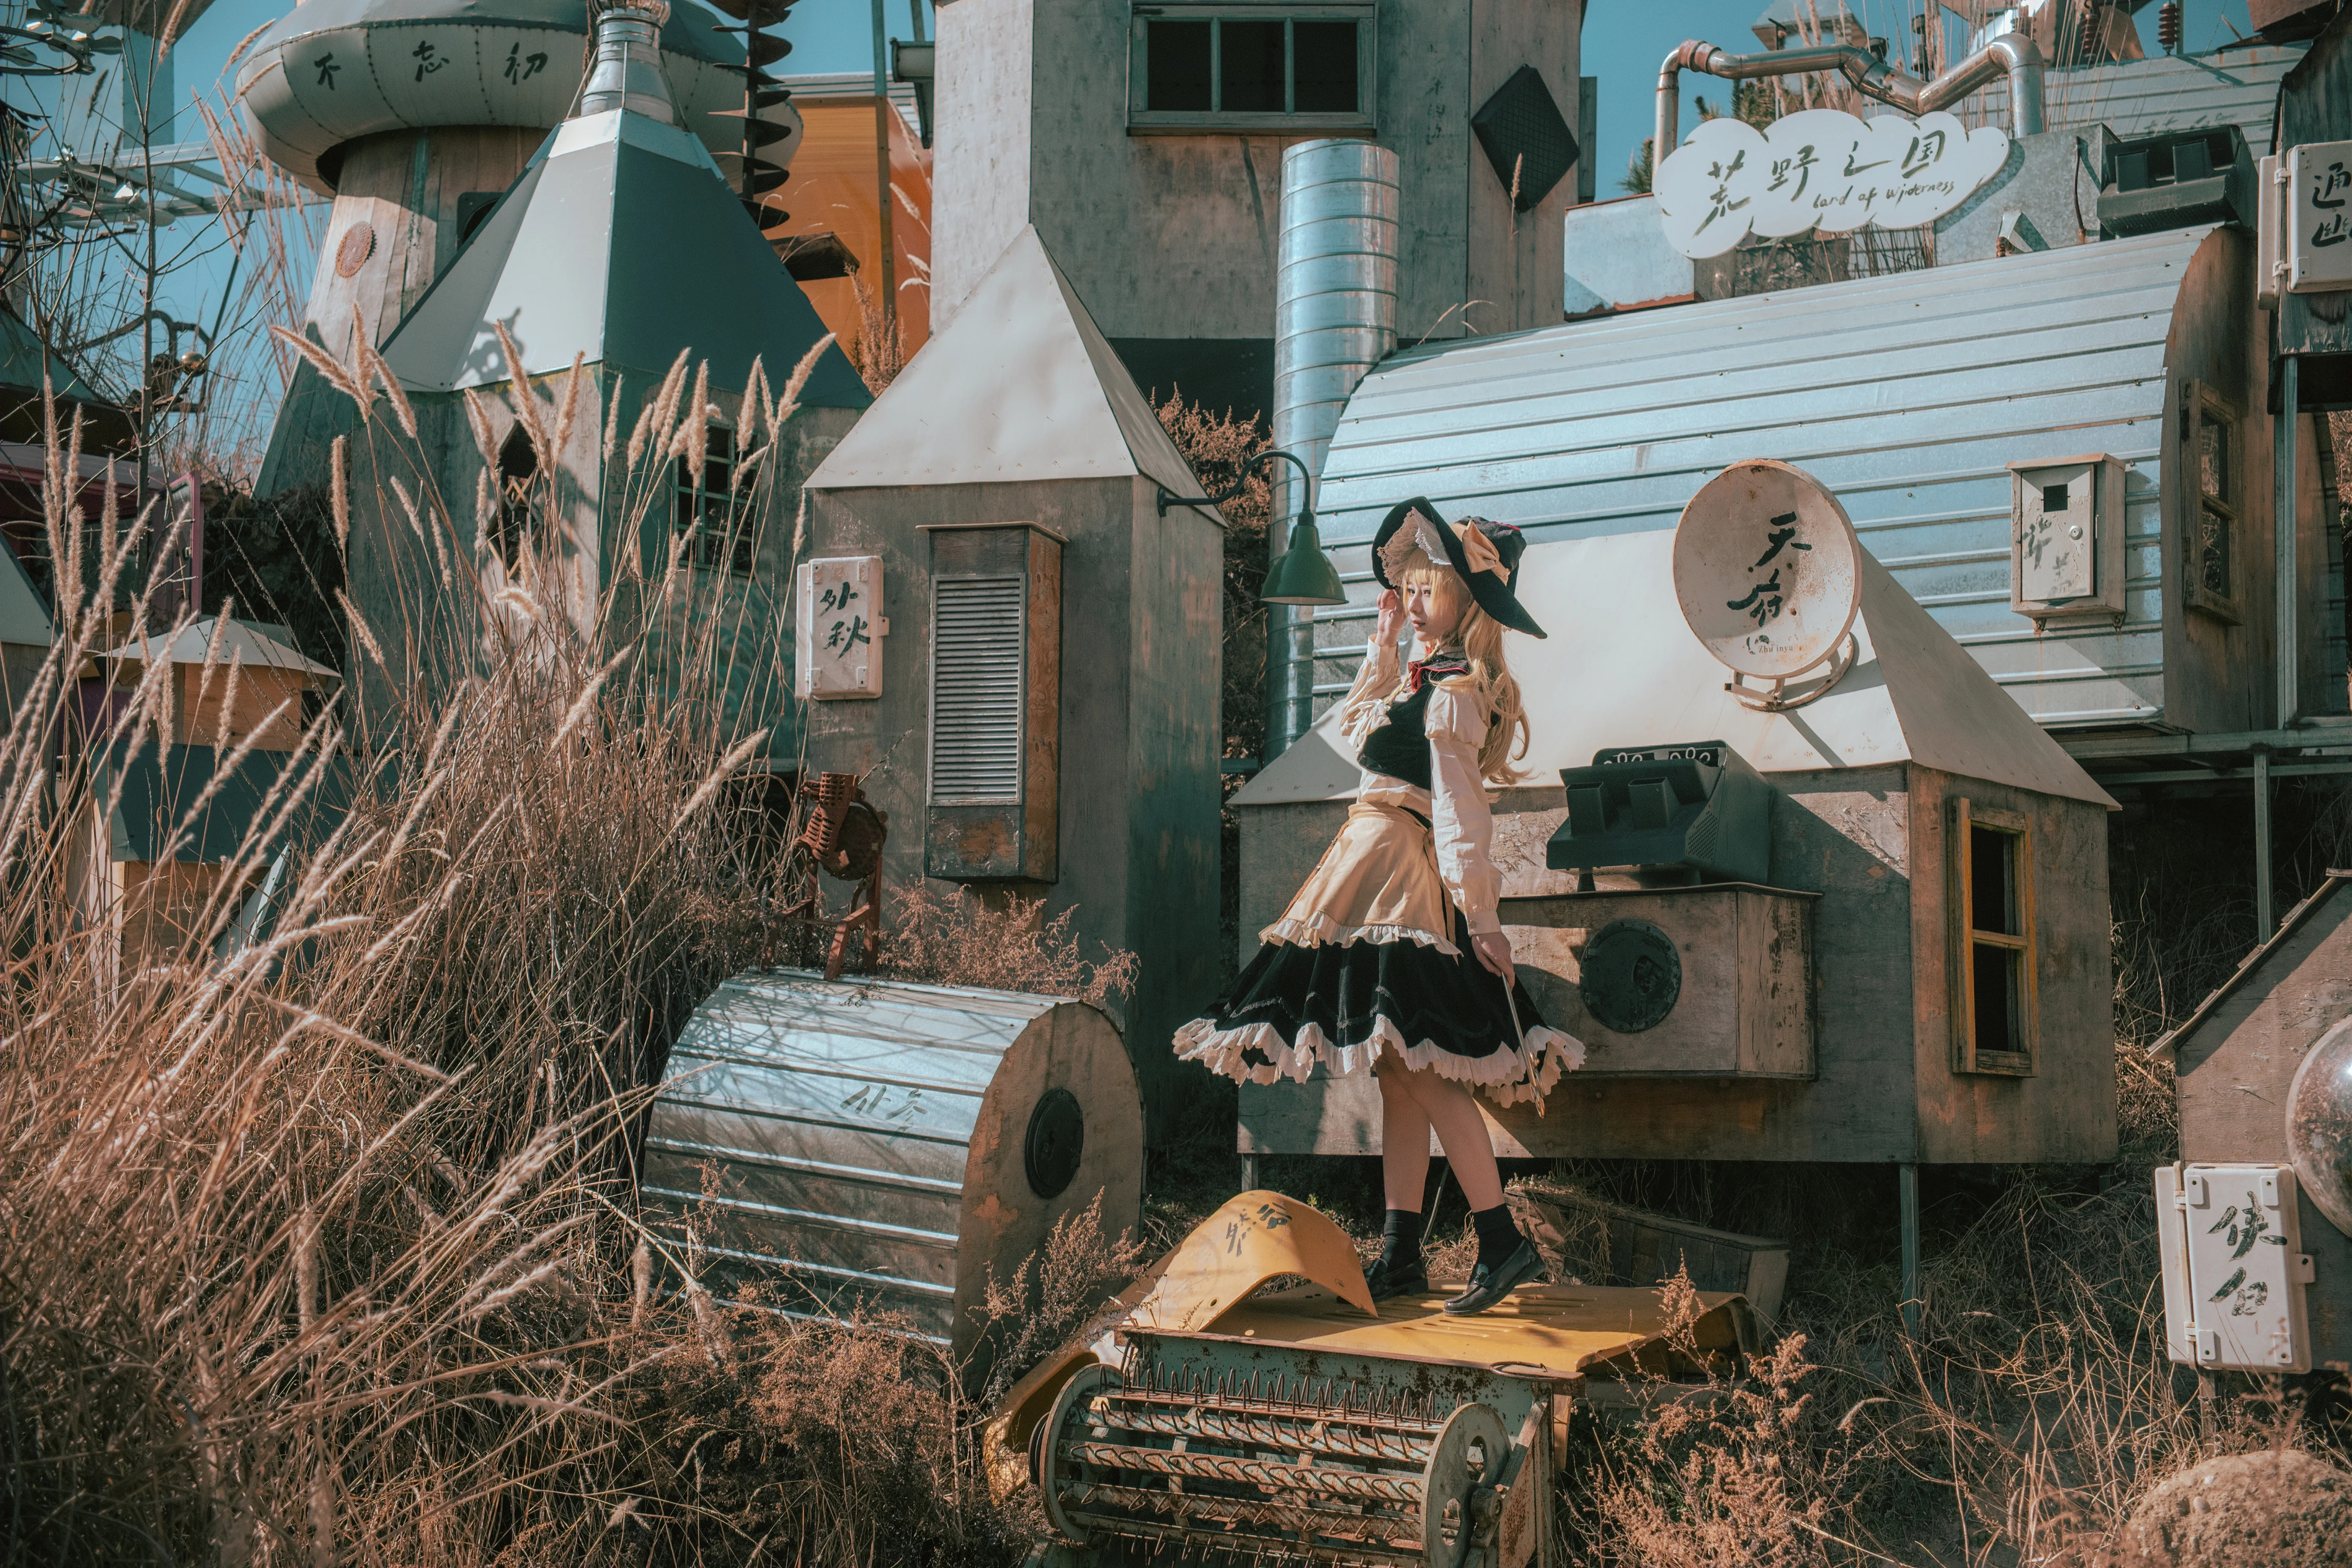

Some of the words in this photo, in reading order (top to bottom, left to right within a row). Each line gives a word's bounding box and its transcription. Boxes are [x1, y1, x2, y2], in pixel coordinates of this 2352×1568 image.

[1692, 130, 1945, 239] 荒野之国
[1727, 511, 1813, 627] 天府
